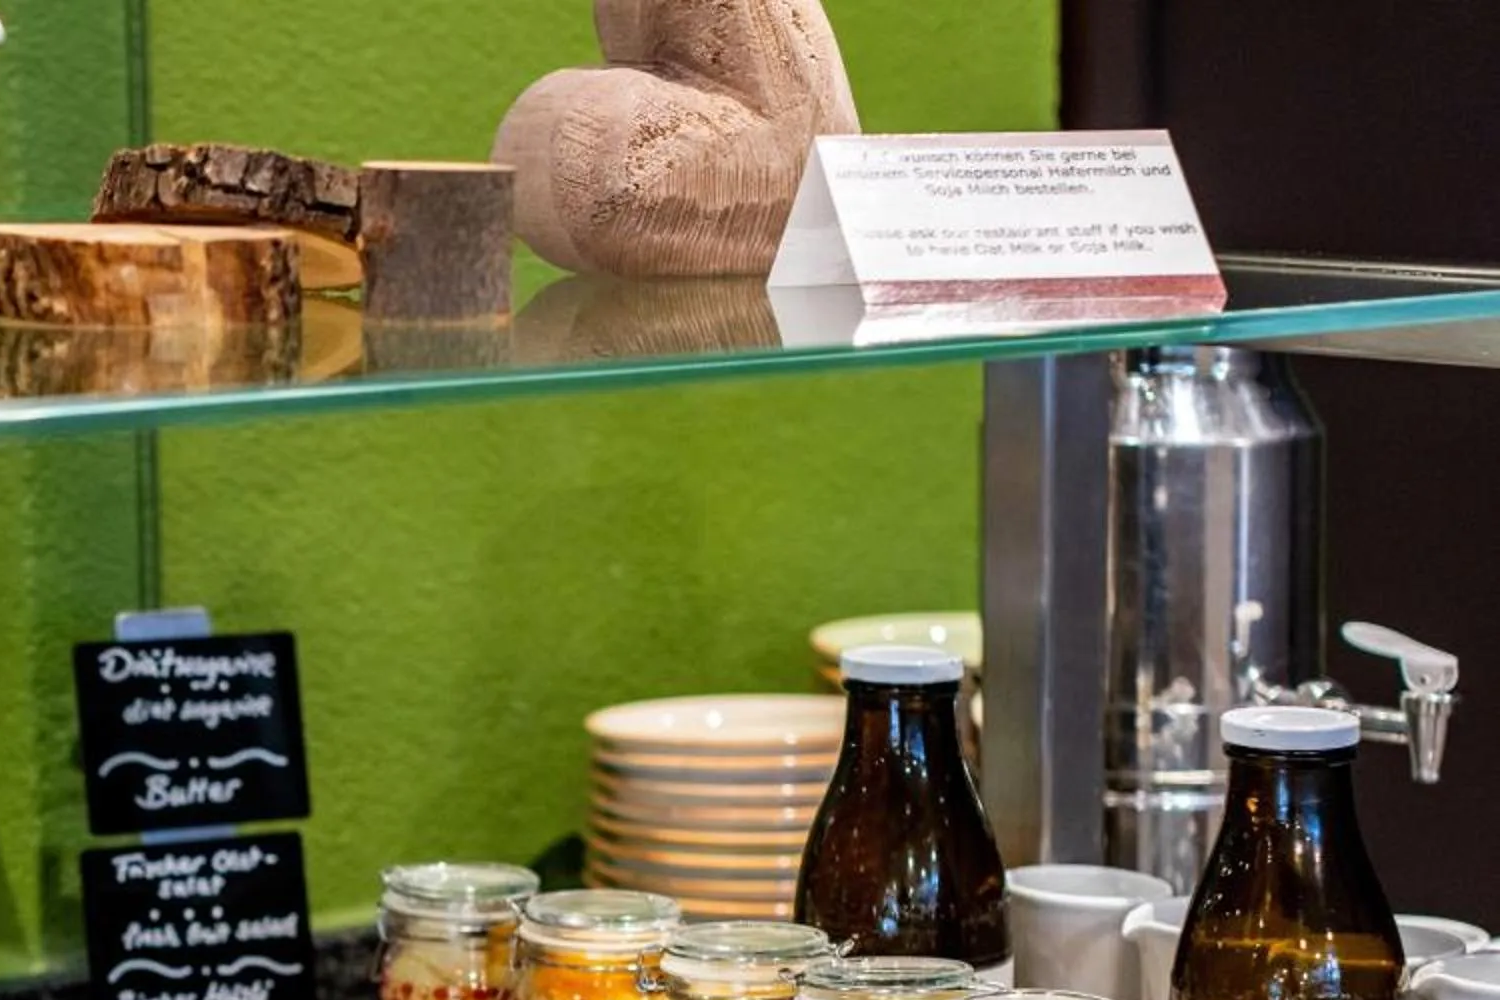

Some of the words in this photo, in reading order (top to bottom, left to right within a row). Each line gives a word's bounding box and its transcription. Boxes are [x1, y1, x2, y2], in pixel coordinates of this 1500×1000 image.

[965, 150, 1026, 163] können
[1030, 149, 1056, 162] Sie
[1060, 151, 1108, 165] gerne
[1111, 148, 1137, 162] bei
[913, 165, 1043, 180] Servicepersonal
[1048, 164, 1136, 178] Hafermilch
[1140, 163, 1172, 177] und
[1124, 224, 1156, 238] you
[1158, 221, 1198, 236] wish
[134, 773, 243, 810] Butter
